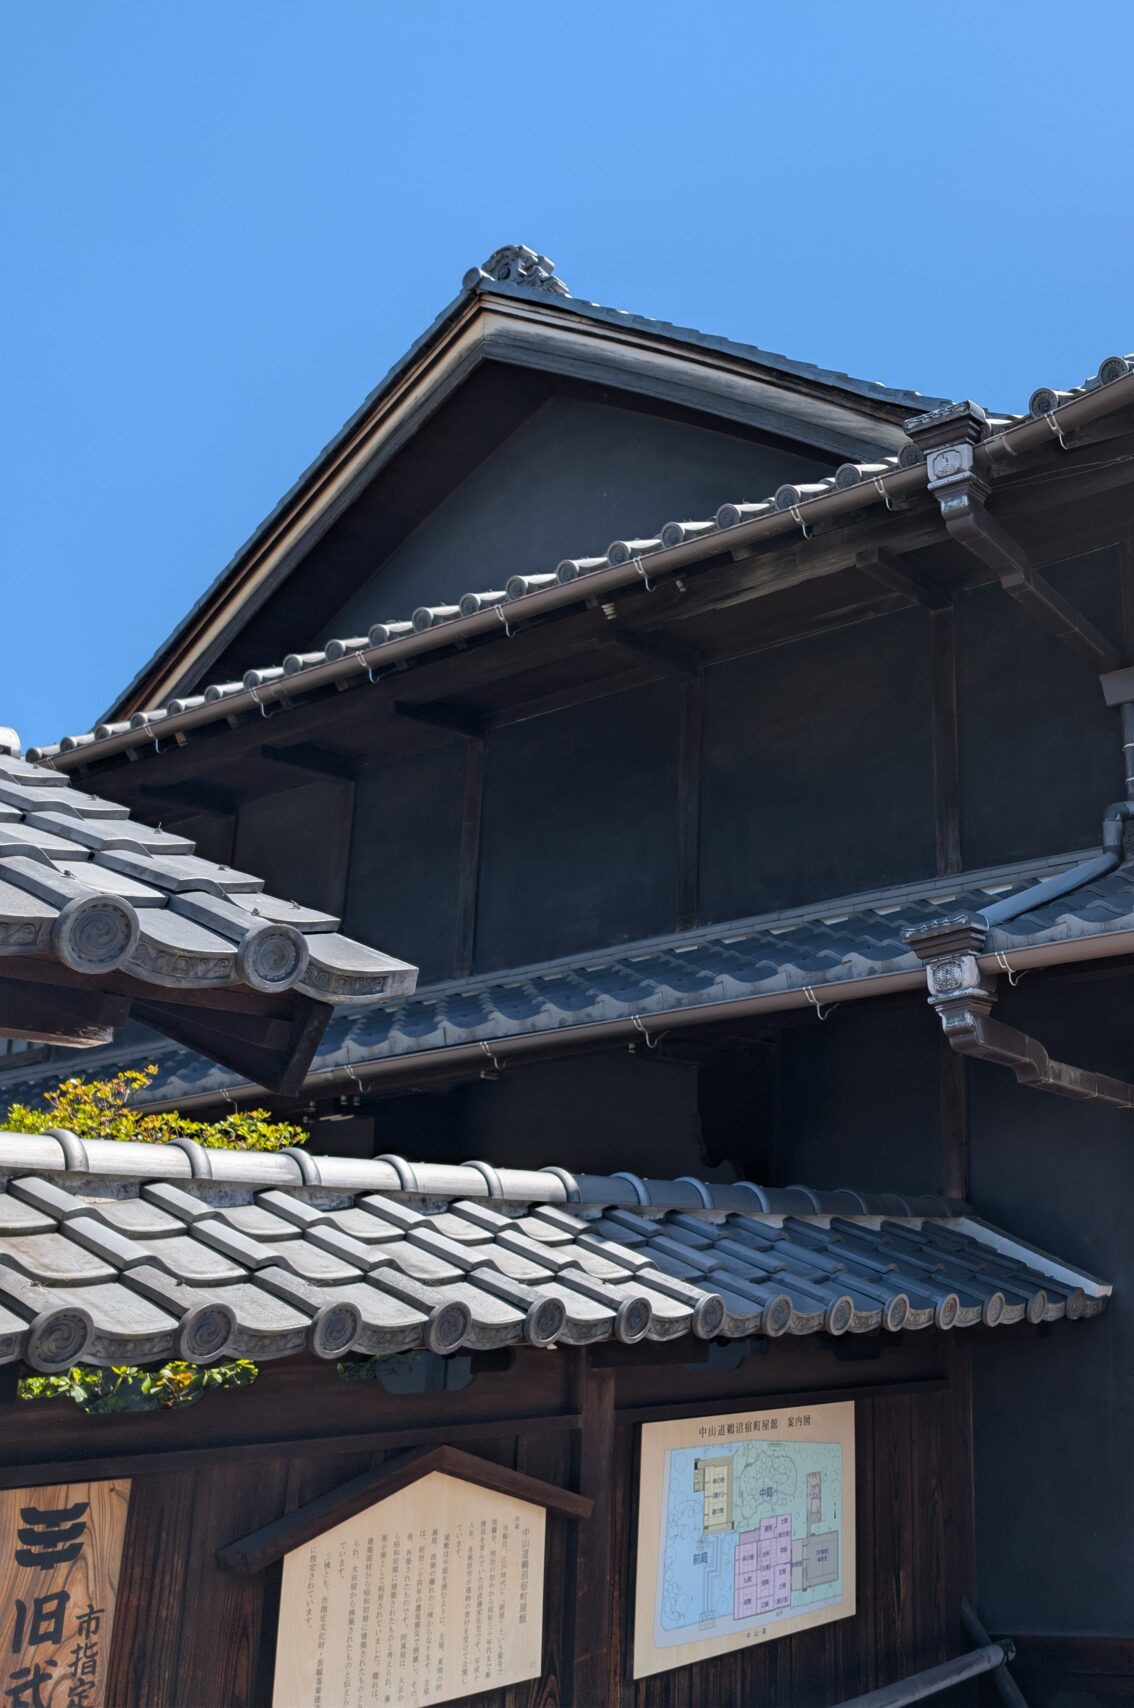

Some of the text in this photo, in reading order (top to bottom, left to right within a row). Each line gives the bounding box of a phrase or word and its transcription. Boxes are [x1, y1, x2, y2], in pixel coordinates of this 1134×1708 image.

[699, 1415, 811, 1438] 中山道鵜沼宿町屋館 案内図
[759, 1487, 774, 1498] 中庭
[692, 1552, 708, 1565] 前庭
[519, 1528, 530, 1624] 中山道鵜沼宿町屋館
[67, 1604, 105, 1708] 市指定
